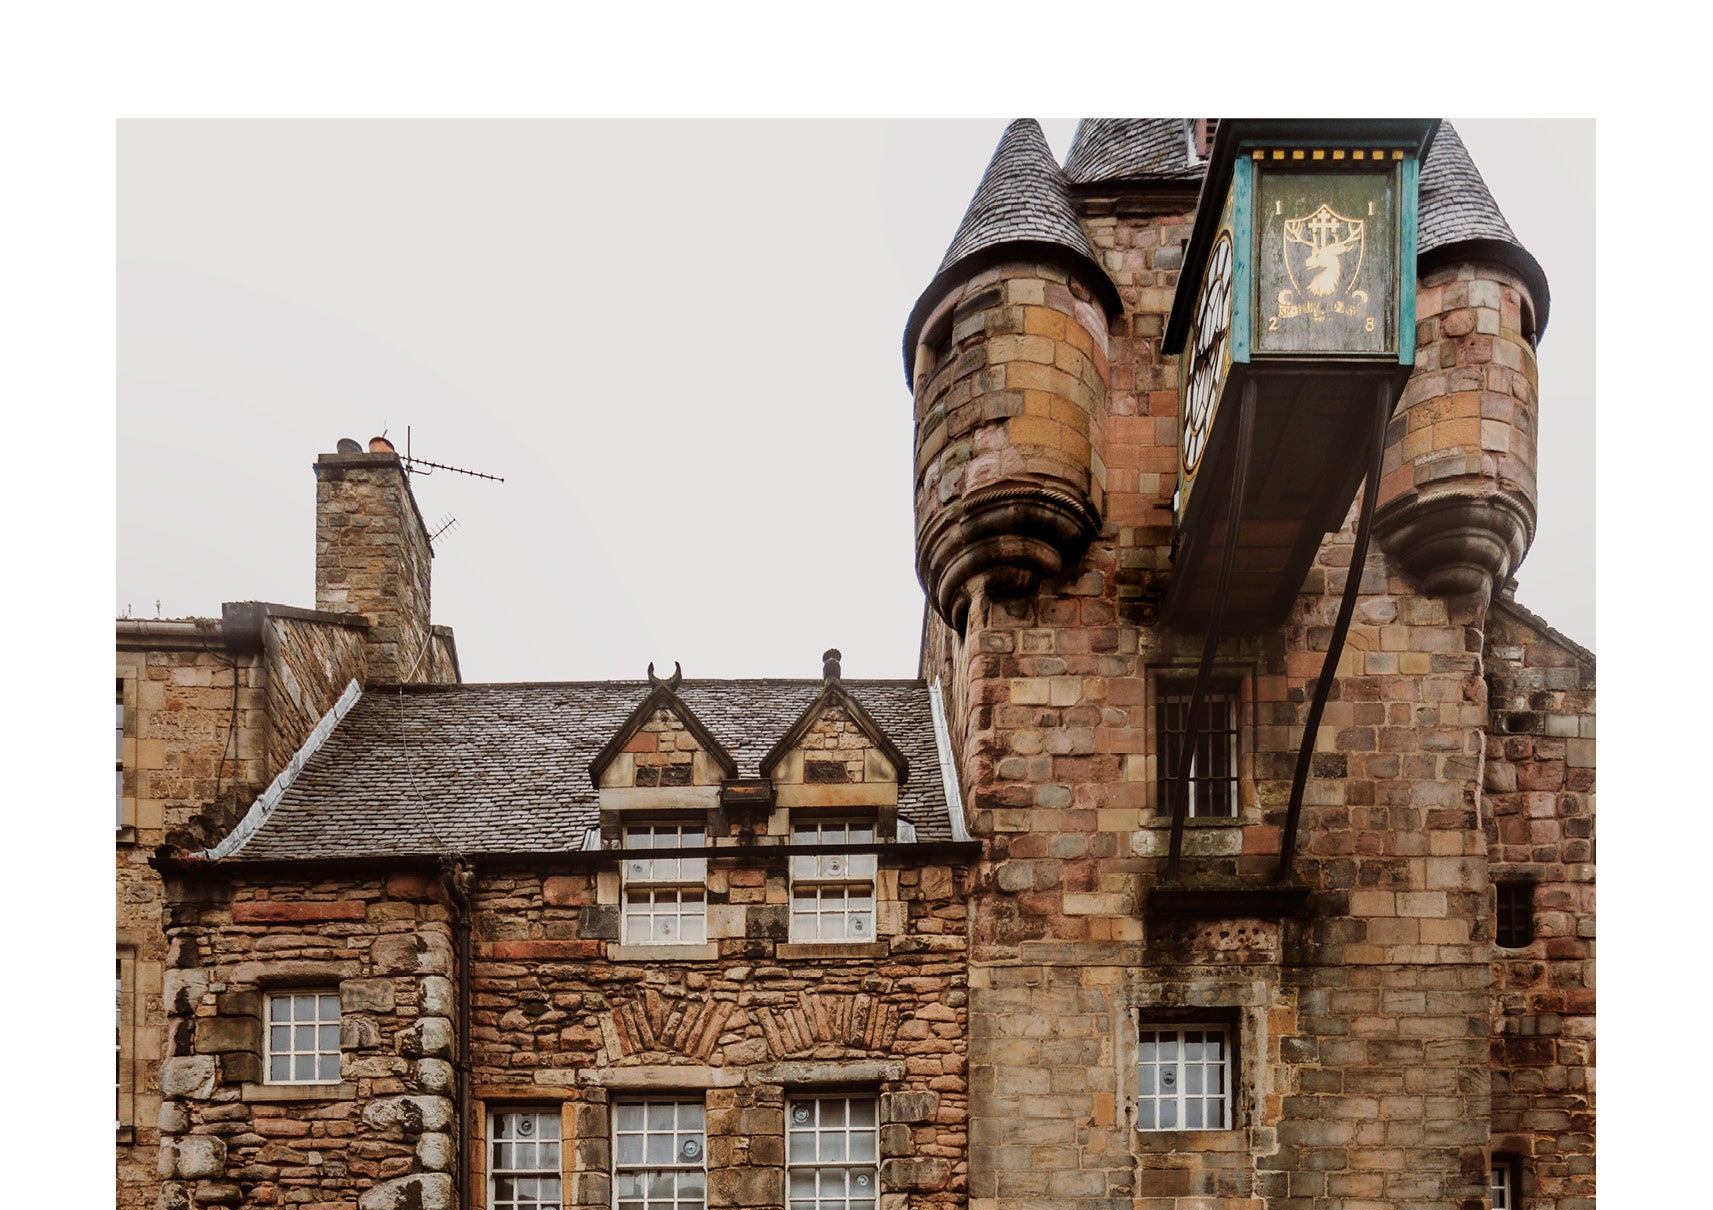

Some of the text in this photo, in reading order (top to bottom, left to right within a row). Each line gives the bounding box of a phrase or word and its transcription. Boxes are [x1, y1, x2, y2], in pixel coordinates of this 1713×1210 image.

[1275, 200, 1374, 216] 1 1
[1268, 316, 1374, 332] 2 8
